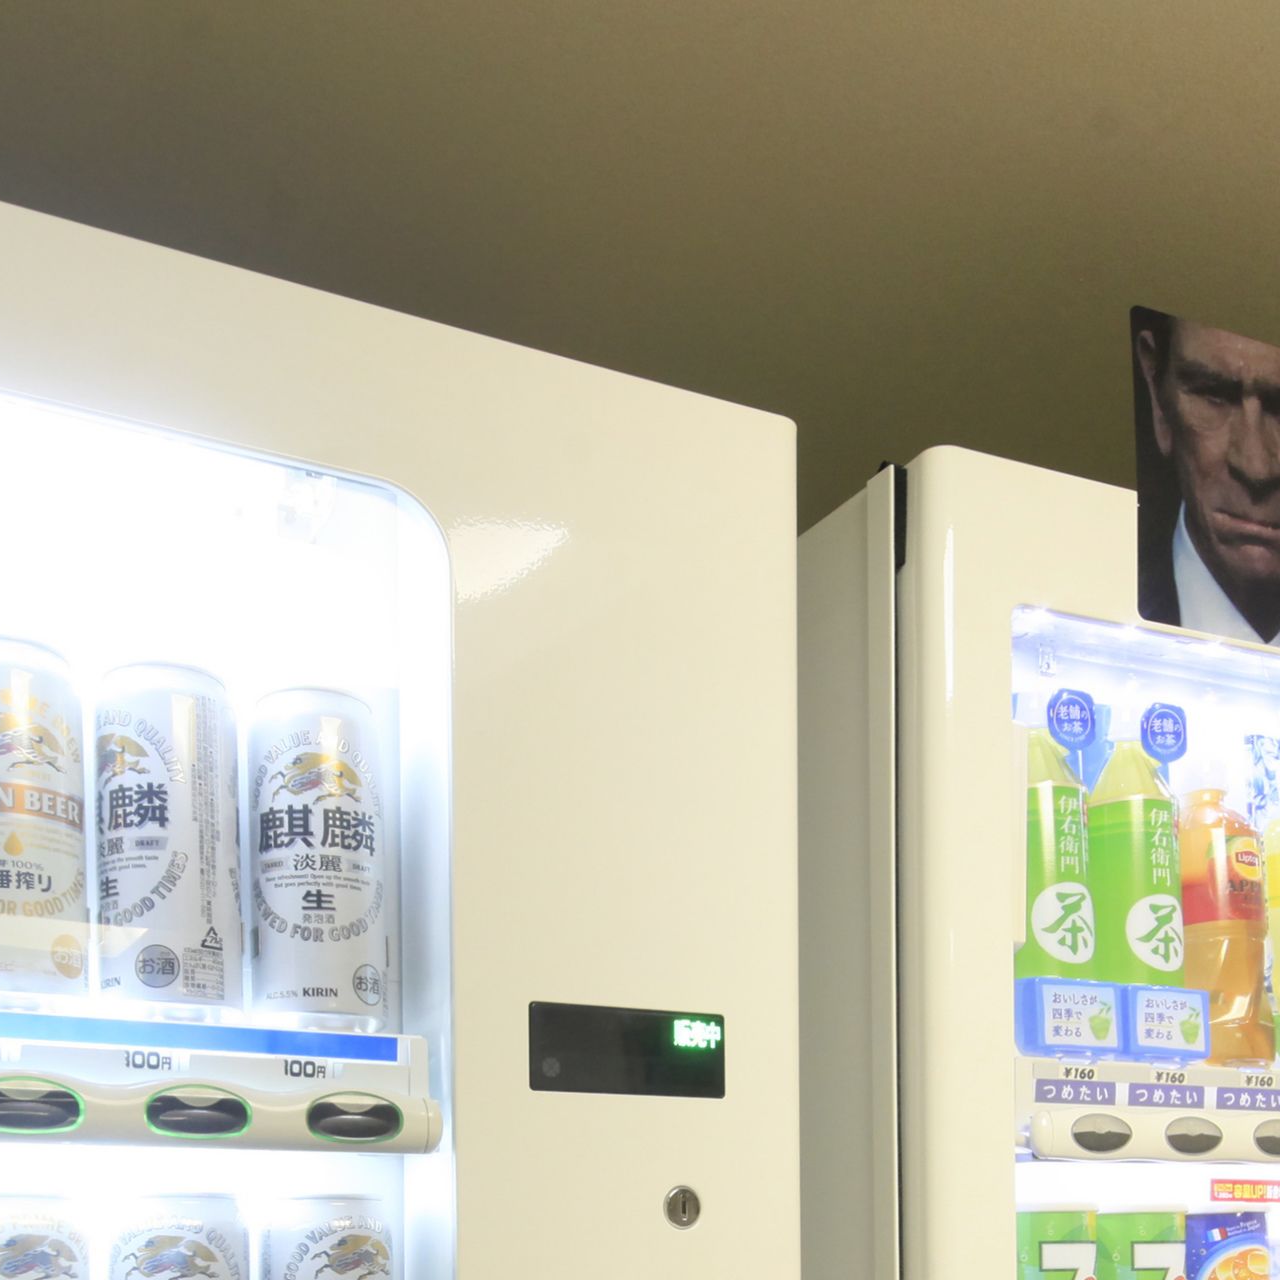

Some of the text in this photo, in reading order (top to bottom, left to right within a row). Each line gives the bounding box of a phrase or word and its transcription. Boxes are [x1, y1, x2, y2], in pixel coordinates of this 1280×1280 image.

[1057, 703, 1088, 721] 老舗の
[1062, 721, 1083, 734] お茶
[1151, 717, 1181, 734] 老舗の
[1154, 734, 1176, 746] お茶
[134, 718, 187, 785] QUALITY
[23, 790, 80, 824] BEER
[259, 804, 375, 857] 麒麟
[1060, 794, 1080, 876] 伊右衛門
[1149, 807, 1172, 888] 伊右衛門
[23, 894, 66, 918] GOOD
[1042, 891, 1093, 956] 茶
[1136, 903, 1183, 961] 茶
[138, 957, 176, 976] お酒
[302, 987, 338, 998] KIRIN
[1052, 992, 1098, 1006] おいしさが
[1144, 997, 1188, 1011] おいしさが
[1052, 1008, 1082, 1022] 四季で
[1144, 1012, 1173, 1026] 四季で
[1052, 1024, 1082, 1038] 変わる
[1144, 1028, 1173, 1041] 変わる
[1064, 1066, 1094, 1081] ¥160
[1156, 1071, 1186, 1085] ¥160
[1042, 1084, 1110, 1103] つめたい
